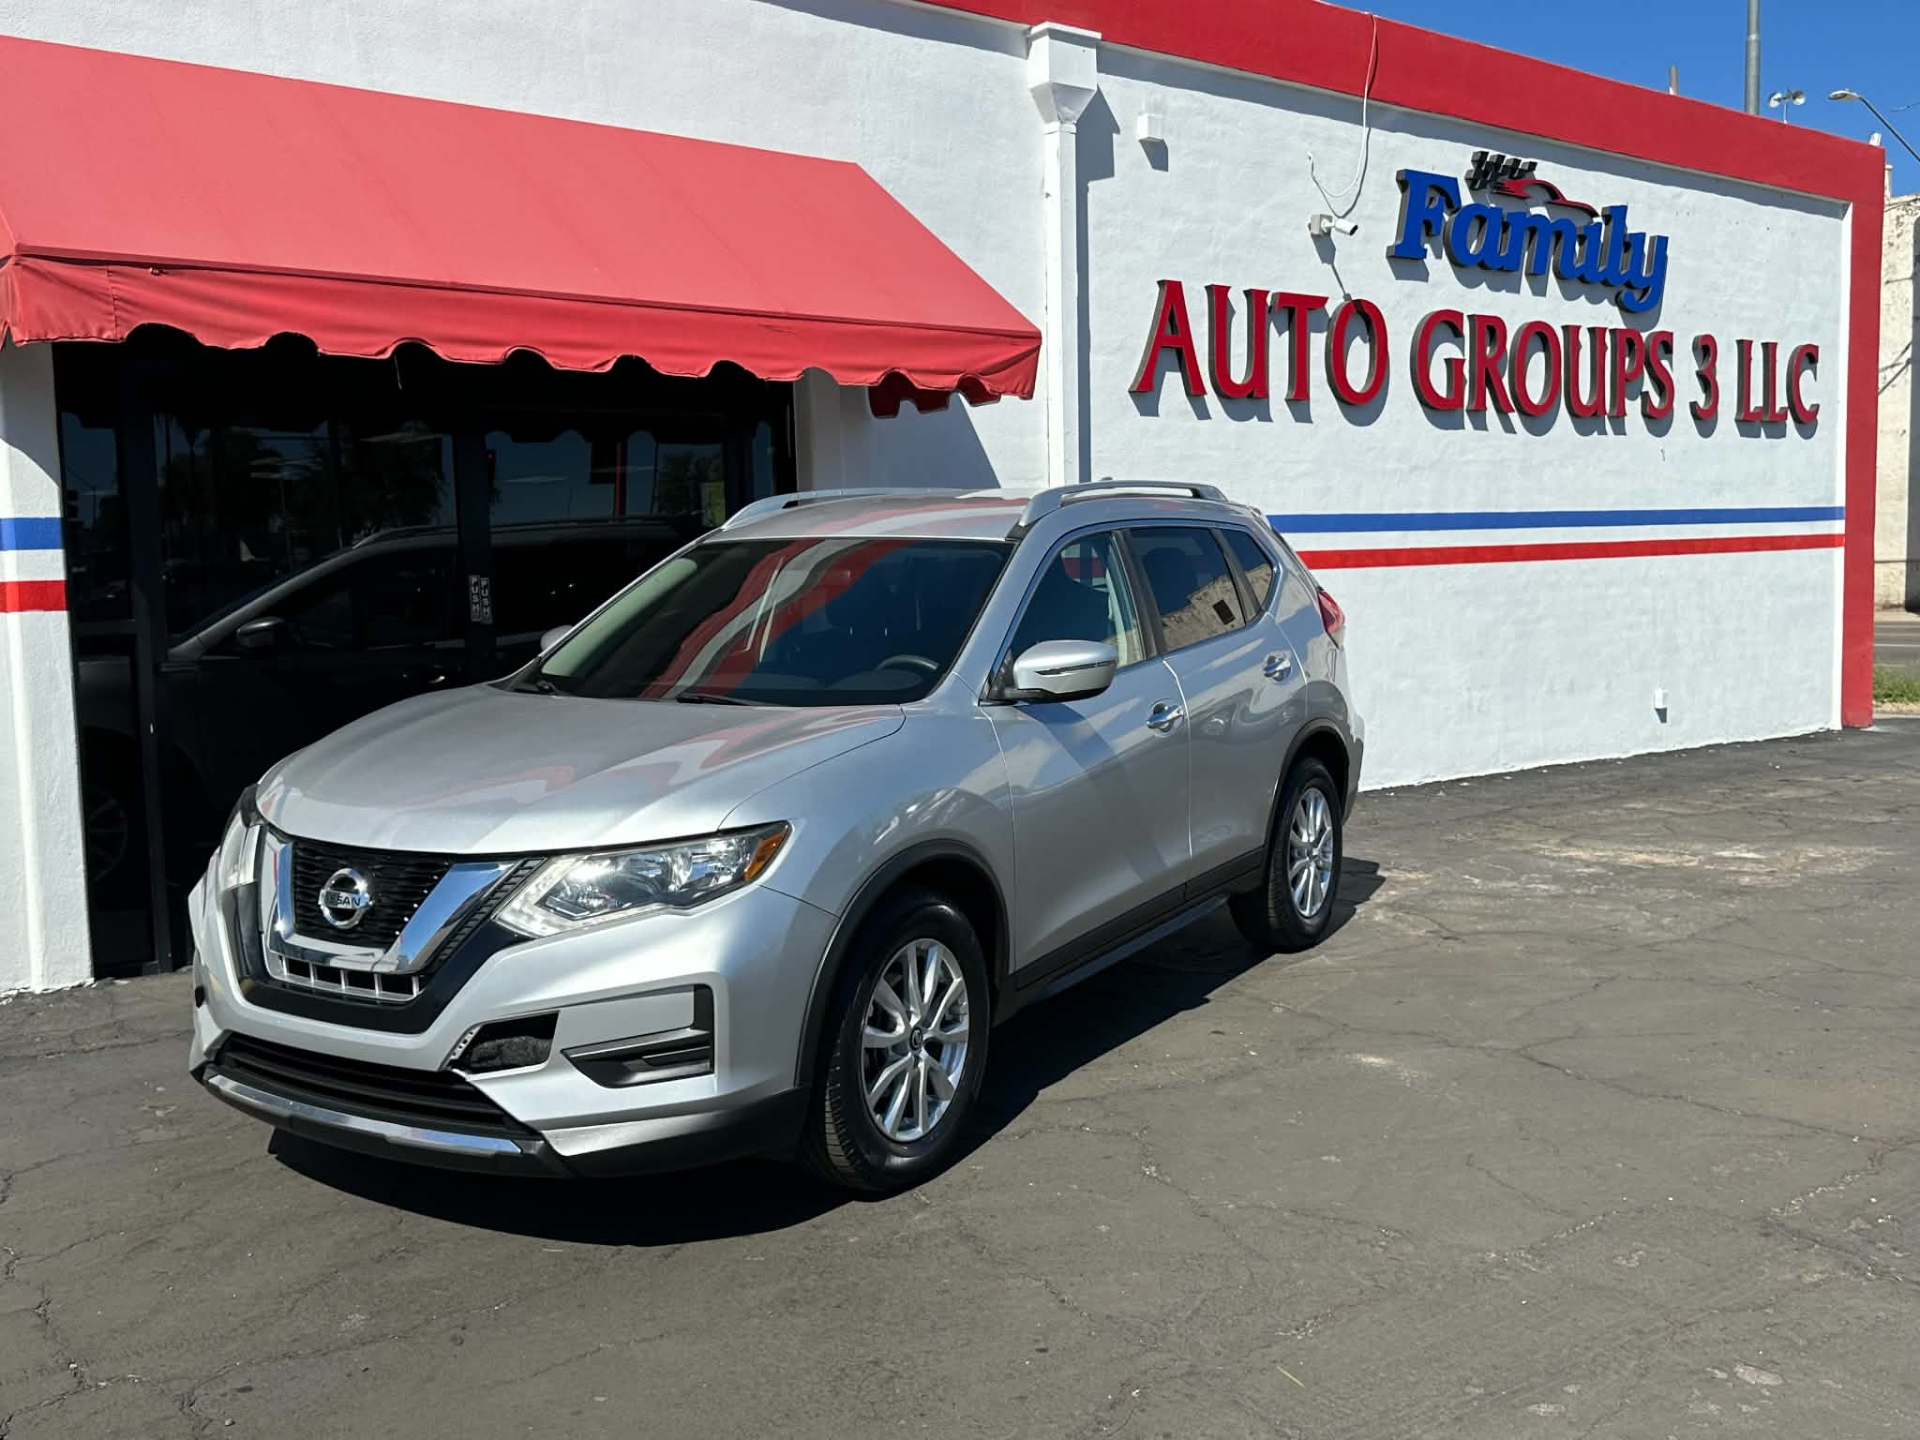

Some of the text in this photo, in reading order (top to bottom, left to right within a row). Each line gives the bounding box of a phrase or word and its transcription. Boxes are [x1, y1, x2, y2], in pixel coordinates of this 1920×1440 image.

[1388, 169, 1668, 313] Family
[1129, 280, 1819, 423] AUTO GROUPS 3 LLC
[325, 892, 361, 907] SAN
